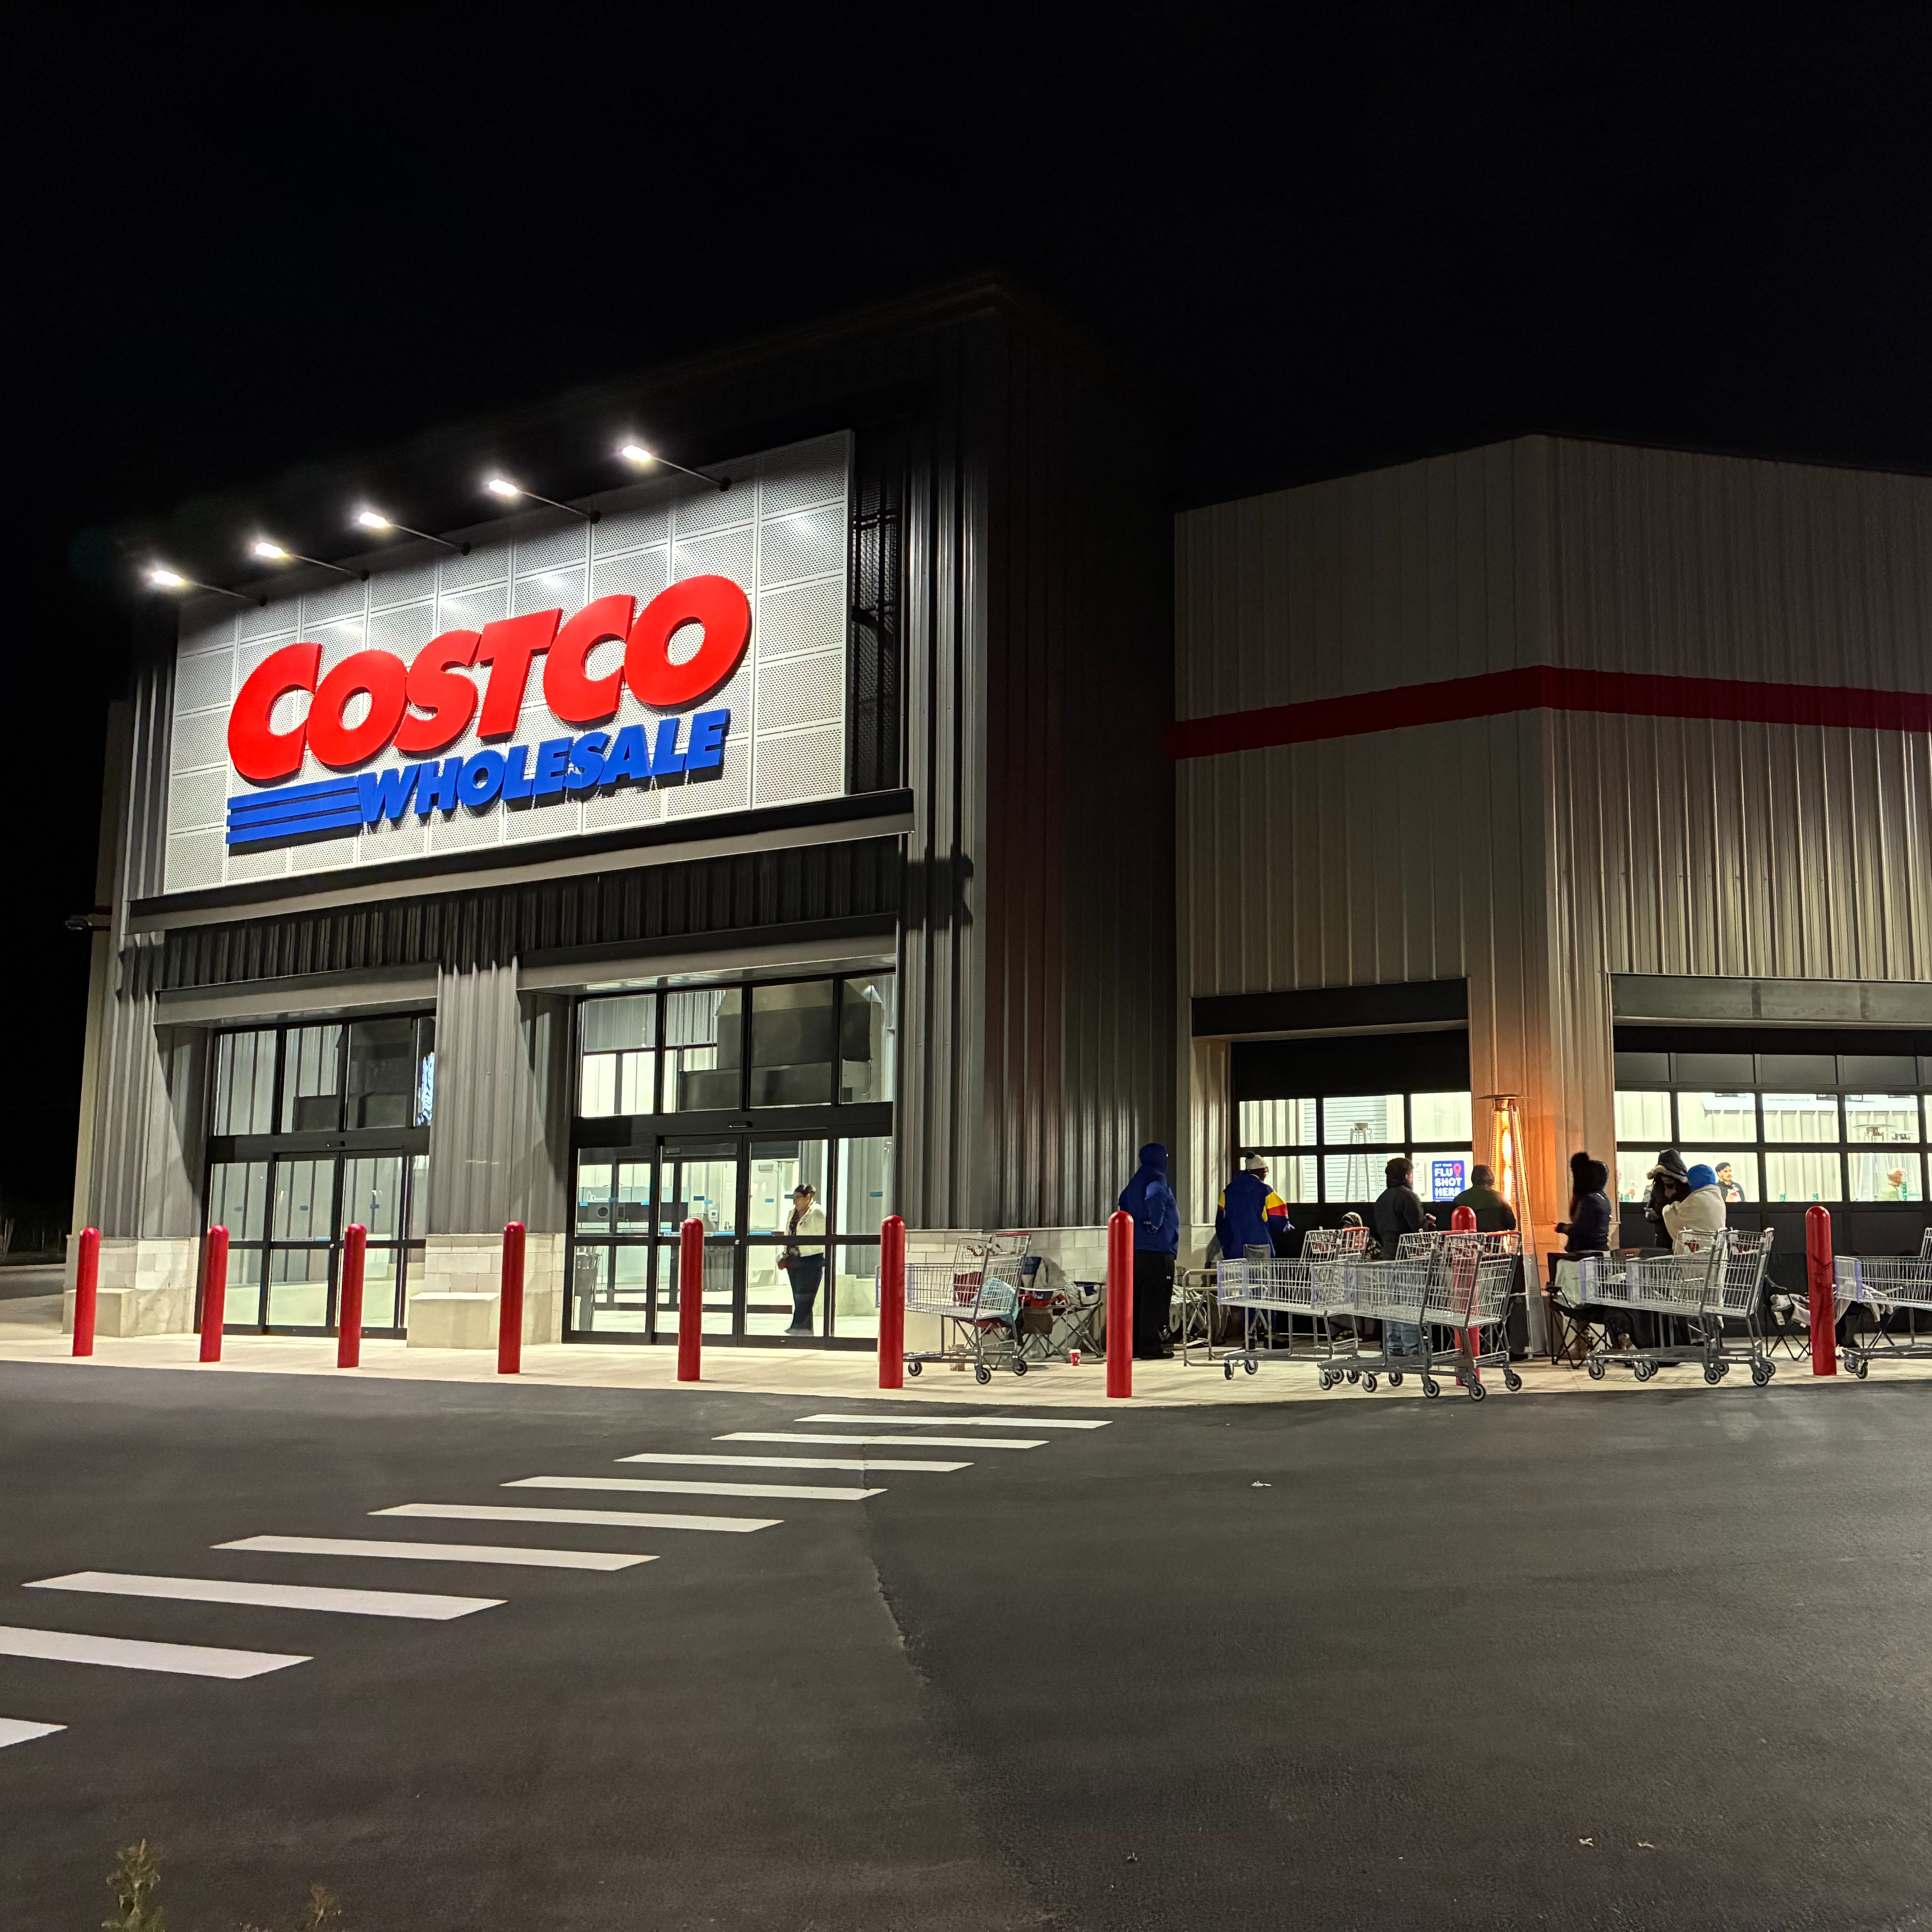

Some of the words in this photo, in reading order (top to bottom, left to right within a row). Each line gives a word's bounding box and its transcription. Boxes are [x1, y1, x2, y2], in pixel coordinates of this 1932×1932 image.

[227, 575, 751, 779] COSTCO
[360, 709, 729, 822] WHOLESALE
[1435, 1168, 1453, 1177] FLU
[1435, 1177, 1463, 1187] SHOT
[1435, 1187, 1461, 1196] HERE
